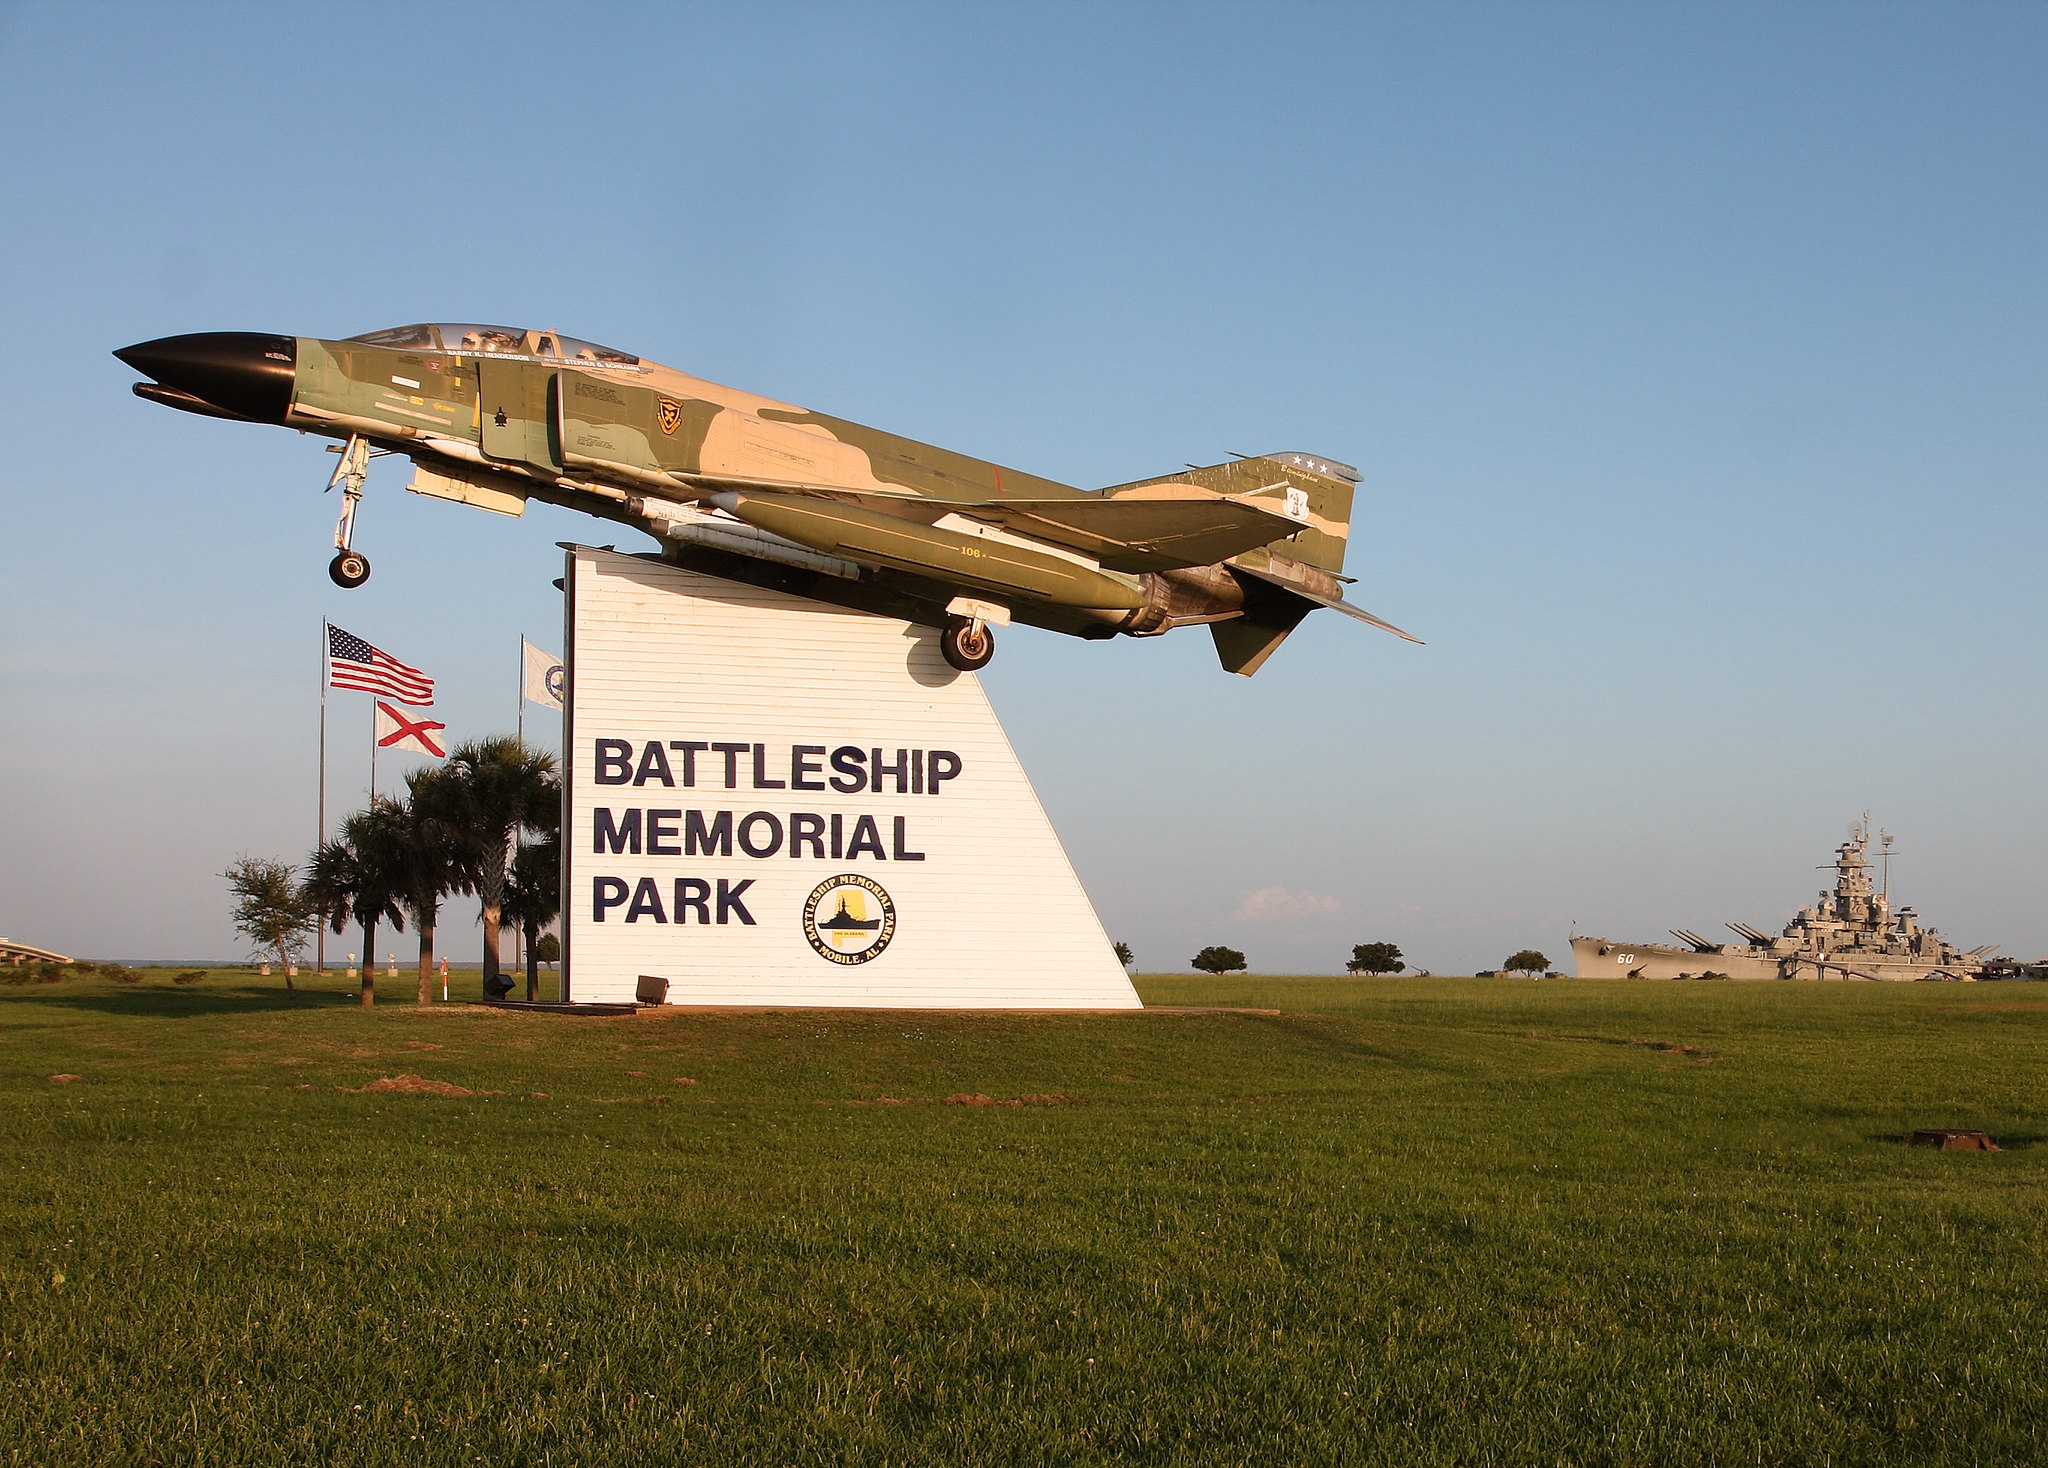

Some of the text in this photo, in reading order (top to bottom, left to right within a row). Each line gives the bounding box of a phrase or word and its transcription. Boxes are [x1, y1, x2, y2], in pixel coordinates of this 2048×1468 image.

[961, 546, 981, 558] 106
[594, 738, 963, 795] BATTLESHIP
[593, 807, 926, 861] MEMORIAL
[593, 876, 757, 925] PARK
[804, 875, 894, 942] BATTLESHIP MEMORIAL PARK
[818, 946, 880, 965] MOBILE, AL
[1617, 953, 1635, 965] 60
